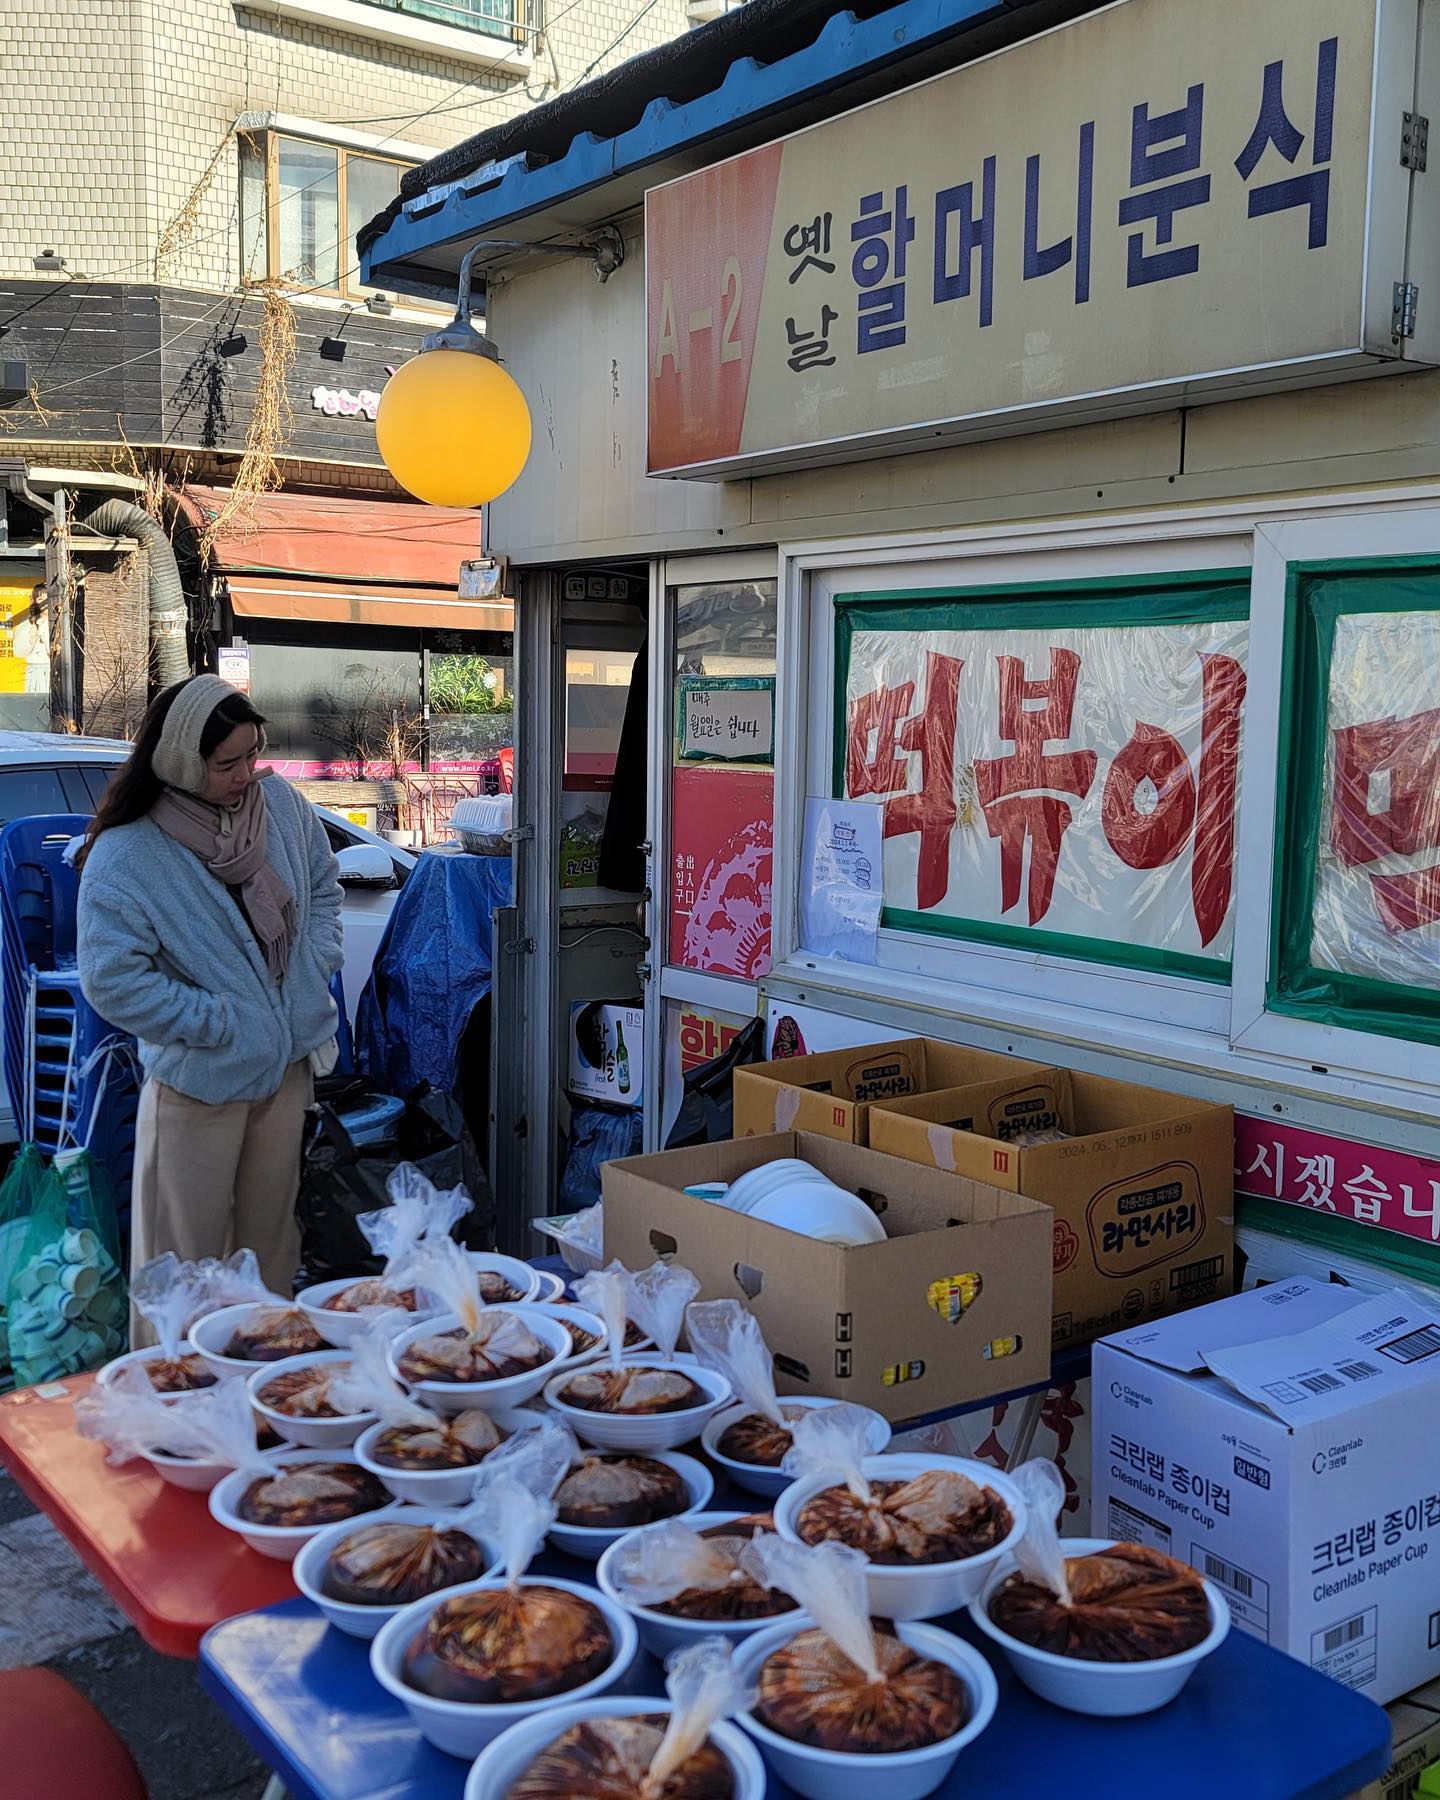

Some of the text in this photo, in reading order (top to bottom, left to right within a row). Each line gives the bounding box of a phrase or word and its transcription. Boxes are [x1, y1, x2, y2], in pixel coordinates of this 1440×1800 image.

[655, 255, 743, 379] A-2
[784, 211, 837, 373] 옛날
[690, 714, 722, 738] 월요일은
[692, 692, 711, 707] 매주
[846, 646, 1248, 949] 떡볶이
[675, 853, 685, 903] 출입구
[685, 854, 695, 904] 出入口
[1233, 1138, 1440, 1240] 시겠습니
[1102, 1202, 1197, 1254] 라면사리
[1109, 1433, 1230, 1517] 크린랩 종이컵
[1328, 1437, 1364, 1458] Cleanlab
[1111, 1465, 1155, 1498] Cleanlab
[1157, 1489, 1190, 1516] Paper
[1191, 1506, 1215, 1530] Cup
[1311, 1519, 1377, 1576] 크린랩
[1313, 1542, 1428, 1602] Cleanlab Paper Cup
